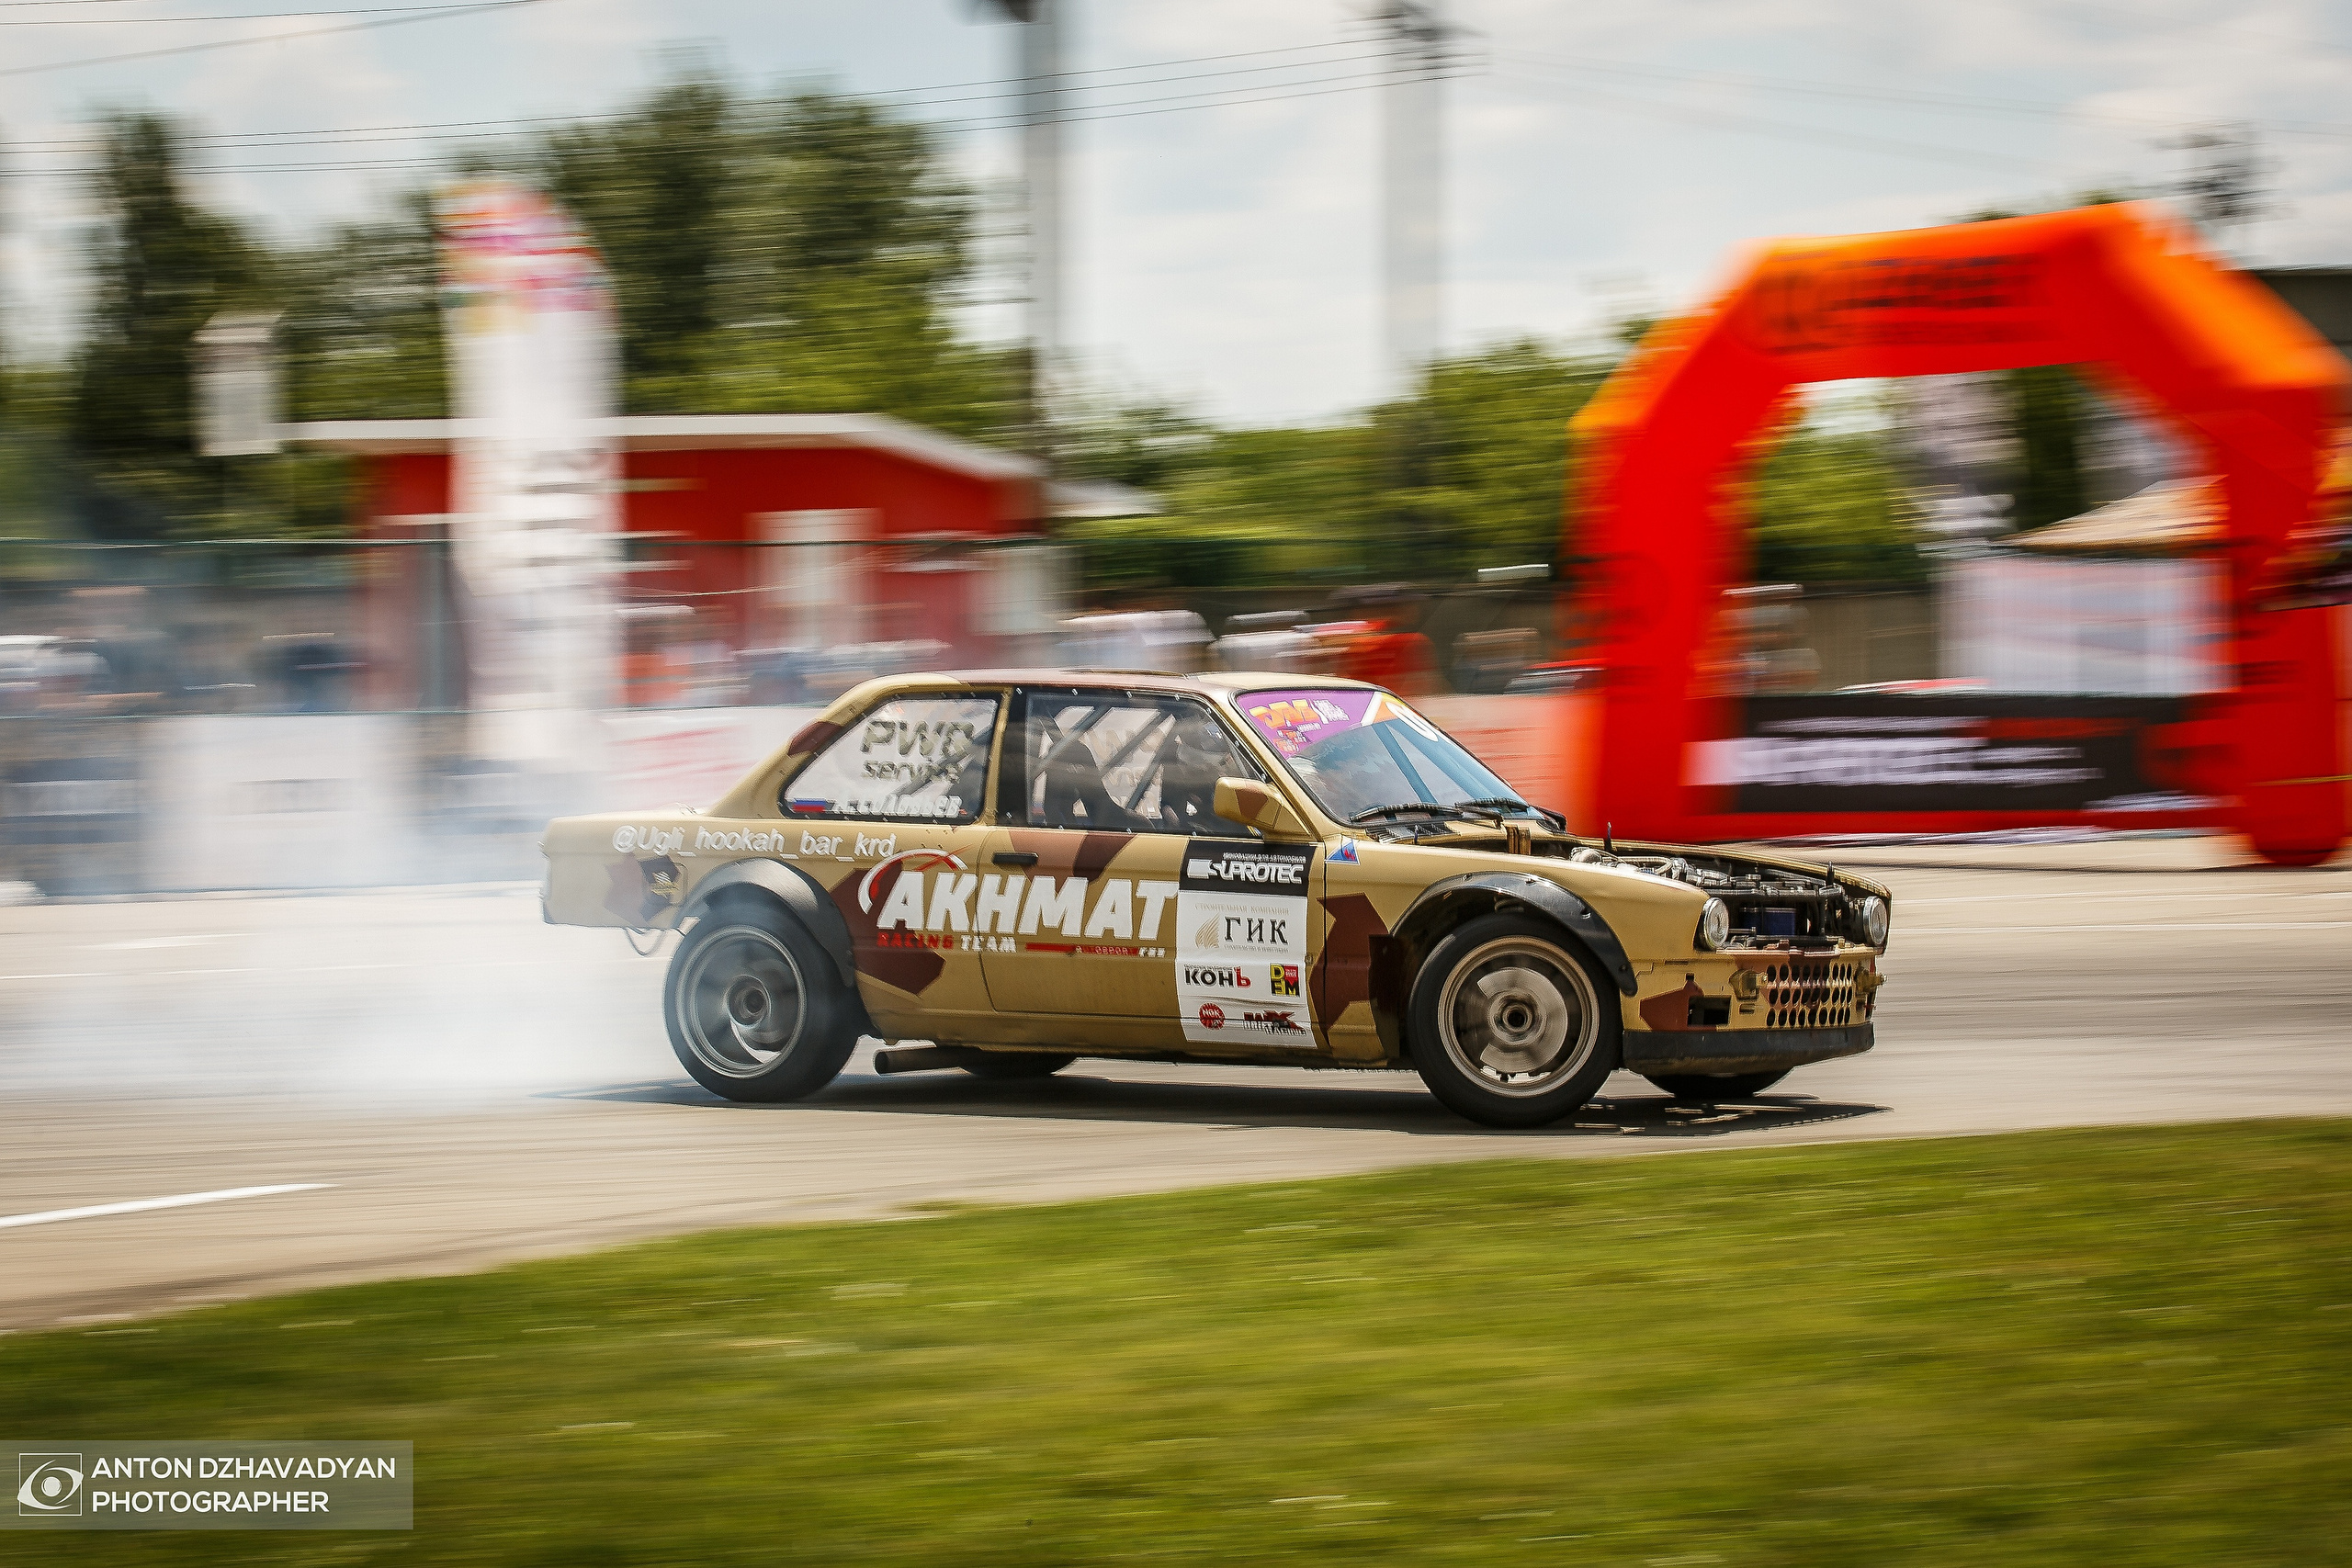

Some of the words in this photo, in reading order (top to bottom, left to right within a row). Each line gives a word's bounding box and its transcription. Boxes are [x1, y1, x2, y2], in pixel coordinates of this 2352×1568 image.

[861, 718, 976, 757] PWR
[612, 823, 898, 863] @Ugli_hookah_bar_krd
[876, 870, 1181, 941] AKHMAT
[877, 932, 955, 950] RACING
[961, 935, 1017, 953] TEAM
[1224, 916, 1289, 946] ГИК
[1185, 966, 1251, 989] КОНЬ
[1202, 1009, 1220, 1019] NGK
[1243, 1021, 1272, 1032] DRIFT
[1264, 1028, 1306, 1037] RACING
